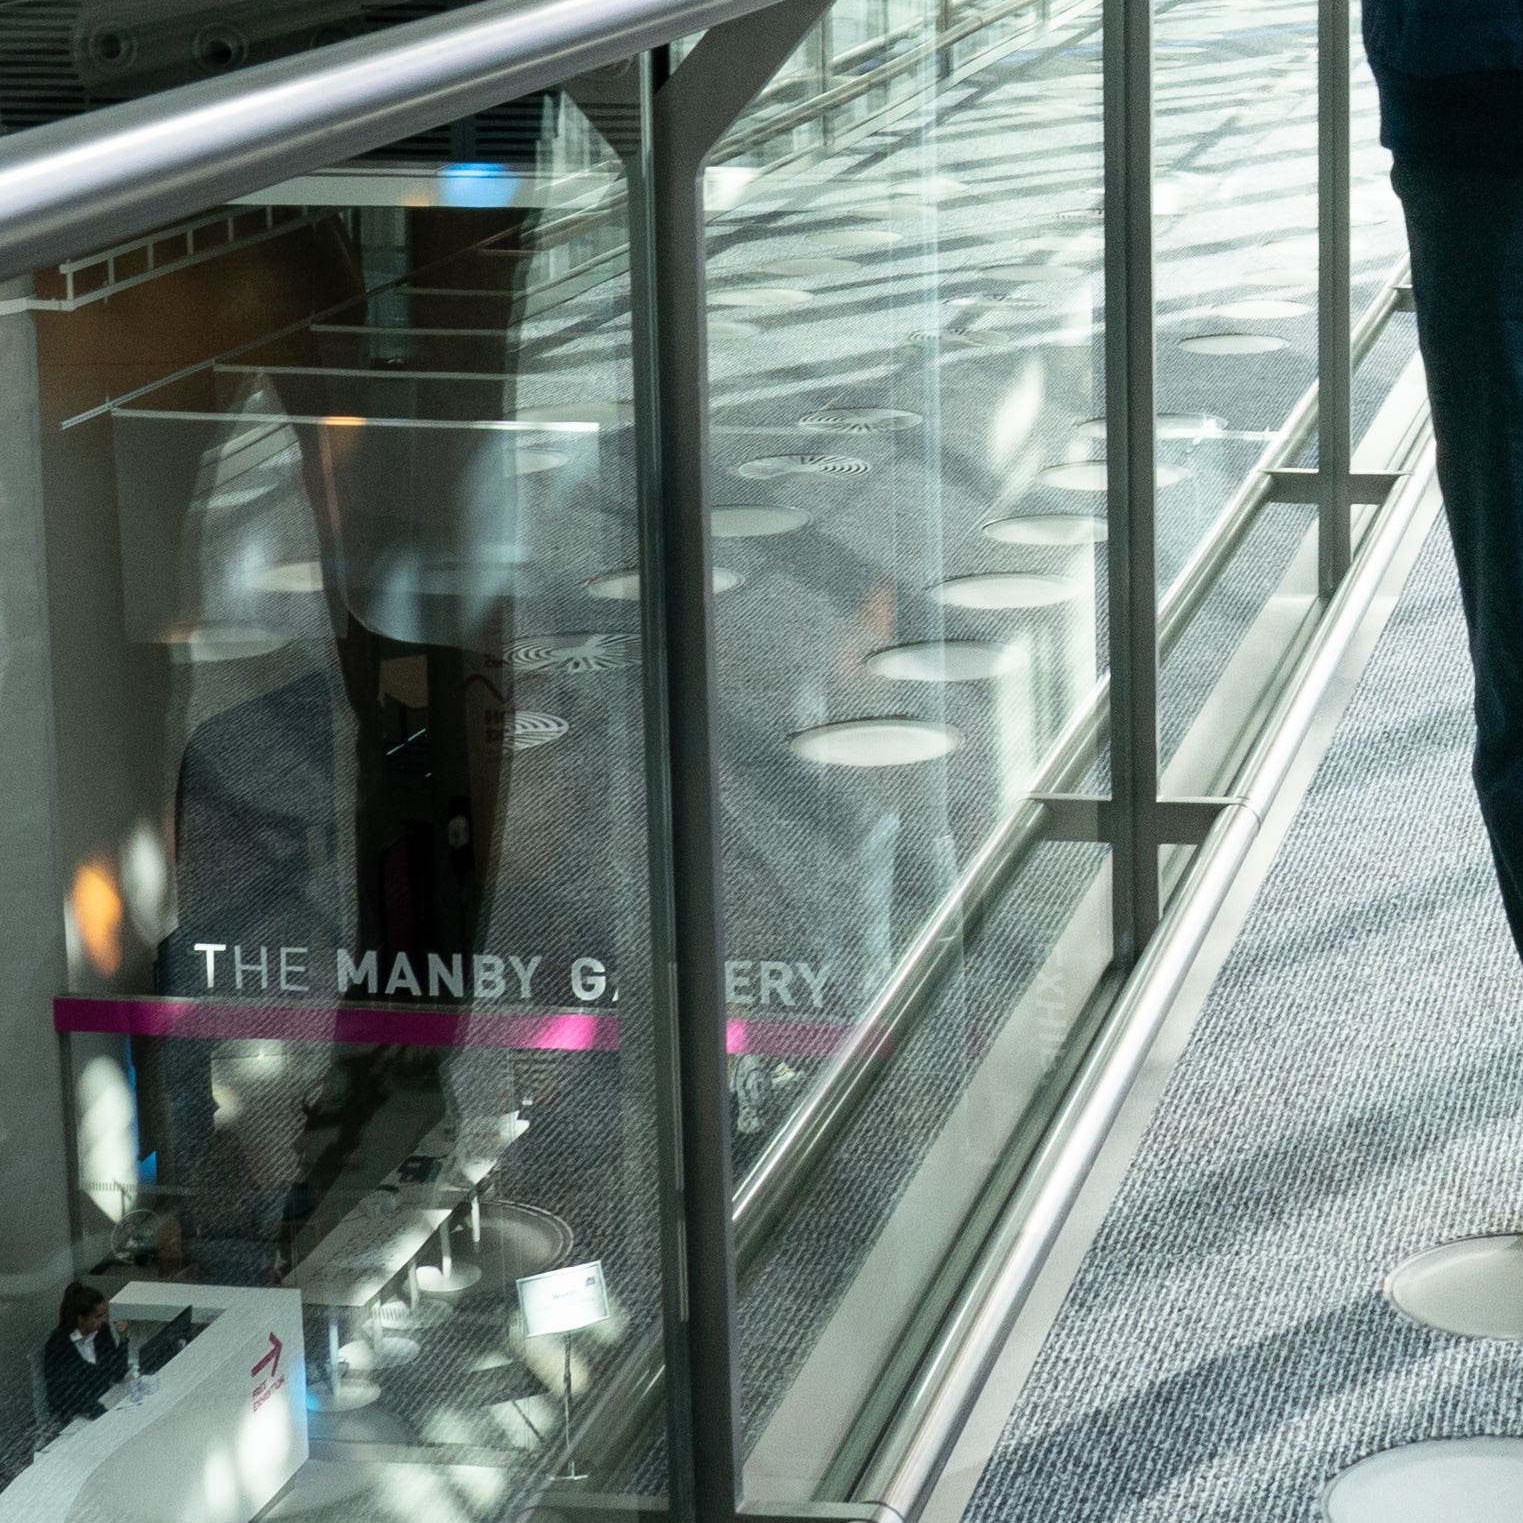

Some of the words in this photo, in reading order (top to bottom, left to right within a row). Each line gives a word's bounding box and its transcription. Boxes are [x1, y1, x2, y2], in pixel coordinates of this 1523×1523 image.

[194, 943, 310, 992] THE
[336, 947, 543, 1000] MANBY
[571, 956, 830, 1009] GERY
